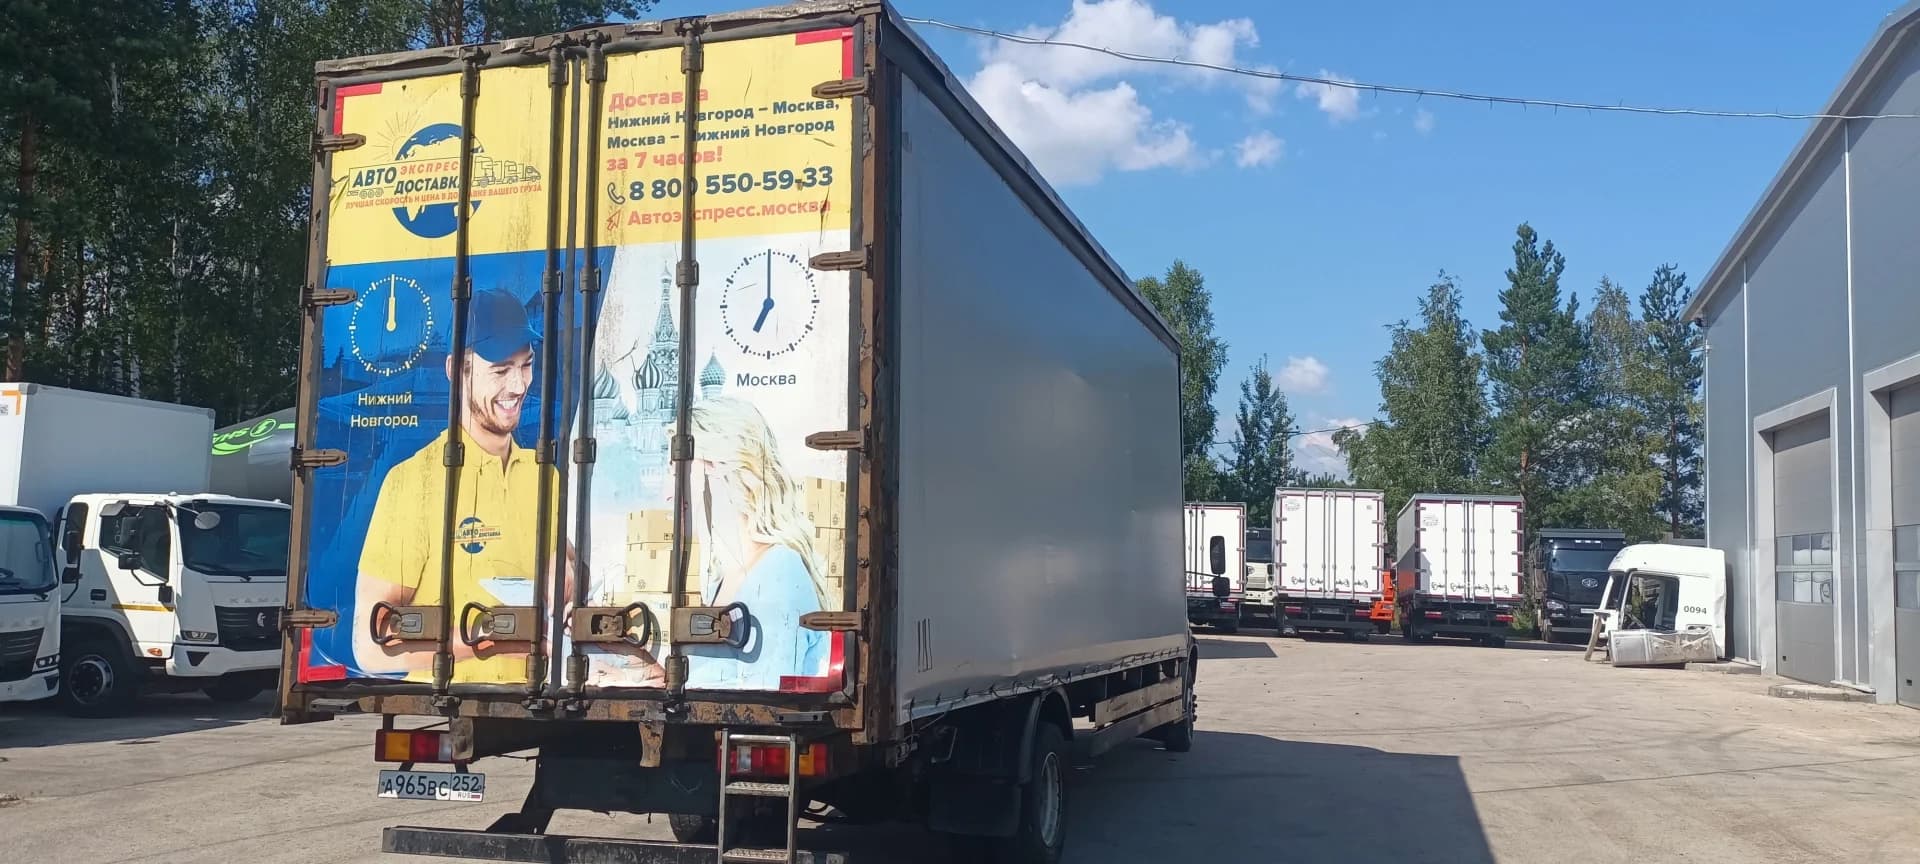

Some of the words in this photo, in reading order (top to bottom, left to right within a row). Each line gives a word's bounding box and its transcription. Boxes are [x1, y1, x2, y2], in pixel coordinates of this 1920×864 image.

[608, 88, 709, 112] Достава
[607, 112, 671, 129] Нижний
[675, 106, 754, 123] Нвгород
[772, 99, 840, 115] Москва,
[607, 135, 666, 149] Москва
[693, 126, 750, 142] ижний
[755, 119, 835, 137] Новгород
[400, 161, 460, 175] ЭКСПРЕС
[606, 157, 628, 171] за
[635, 151, 648, 168] 7
[653, 146, 723, 166] часов!
[352, 166, 397, 188] АВТО
[394, 175, 460, 195] ДОСТАВК
[629, 181, 645, 200] 8
[651, 177, 698, 199] 800
[706, 165, 833, 194] 550-59-33
[447, 189, 487, 200] ДОАВКЕ
[520, 183, 542, 194] ГРУЗА
[628, 199, 831, 226] Автоэспресс.москва
[736, 373, 797, 387] Москва
[358, 391, 412, 406] Нижний
[351, 414, 418, 429] Новгород
[1683, 605, 1707, 614] 0094
[452, 775, 480, 792] 252
